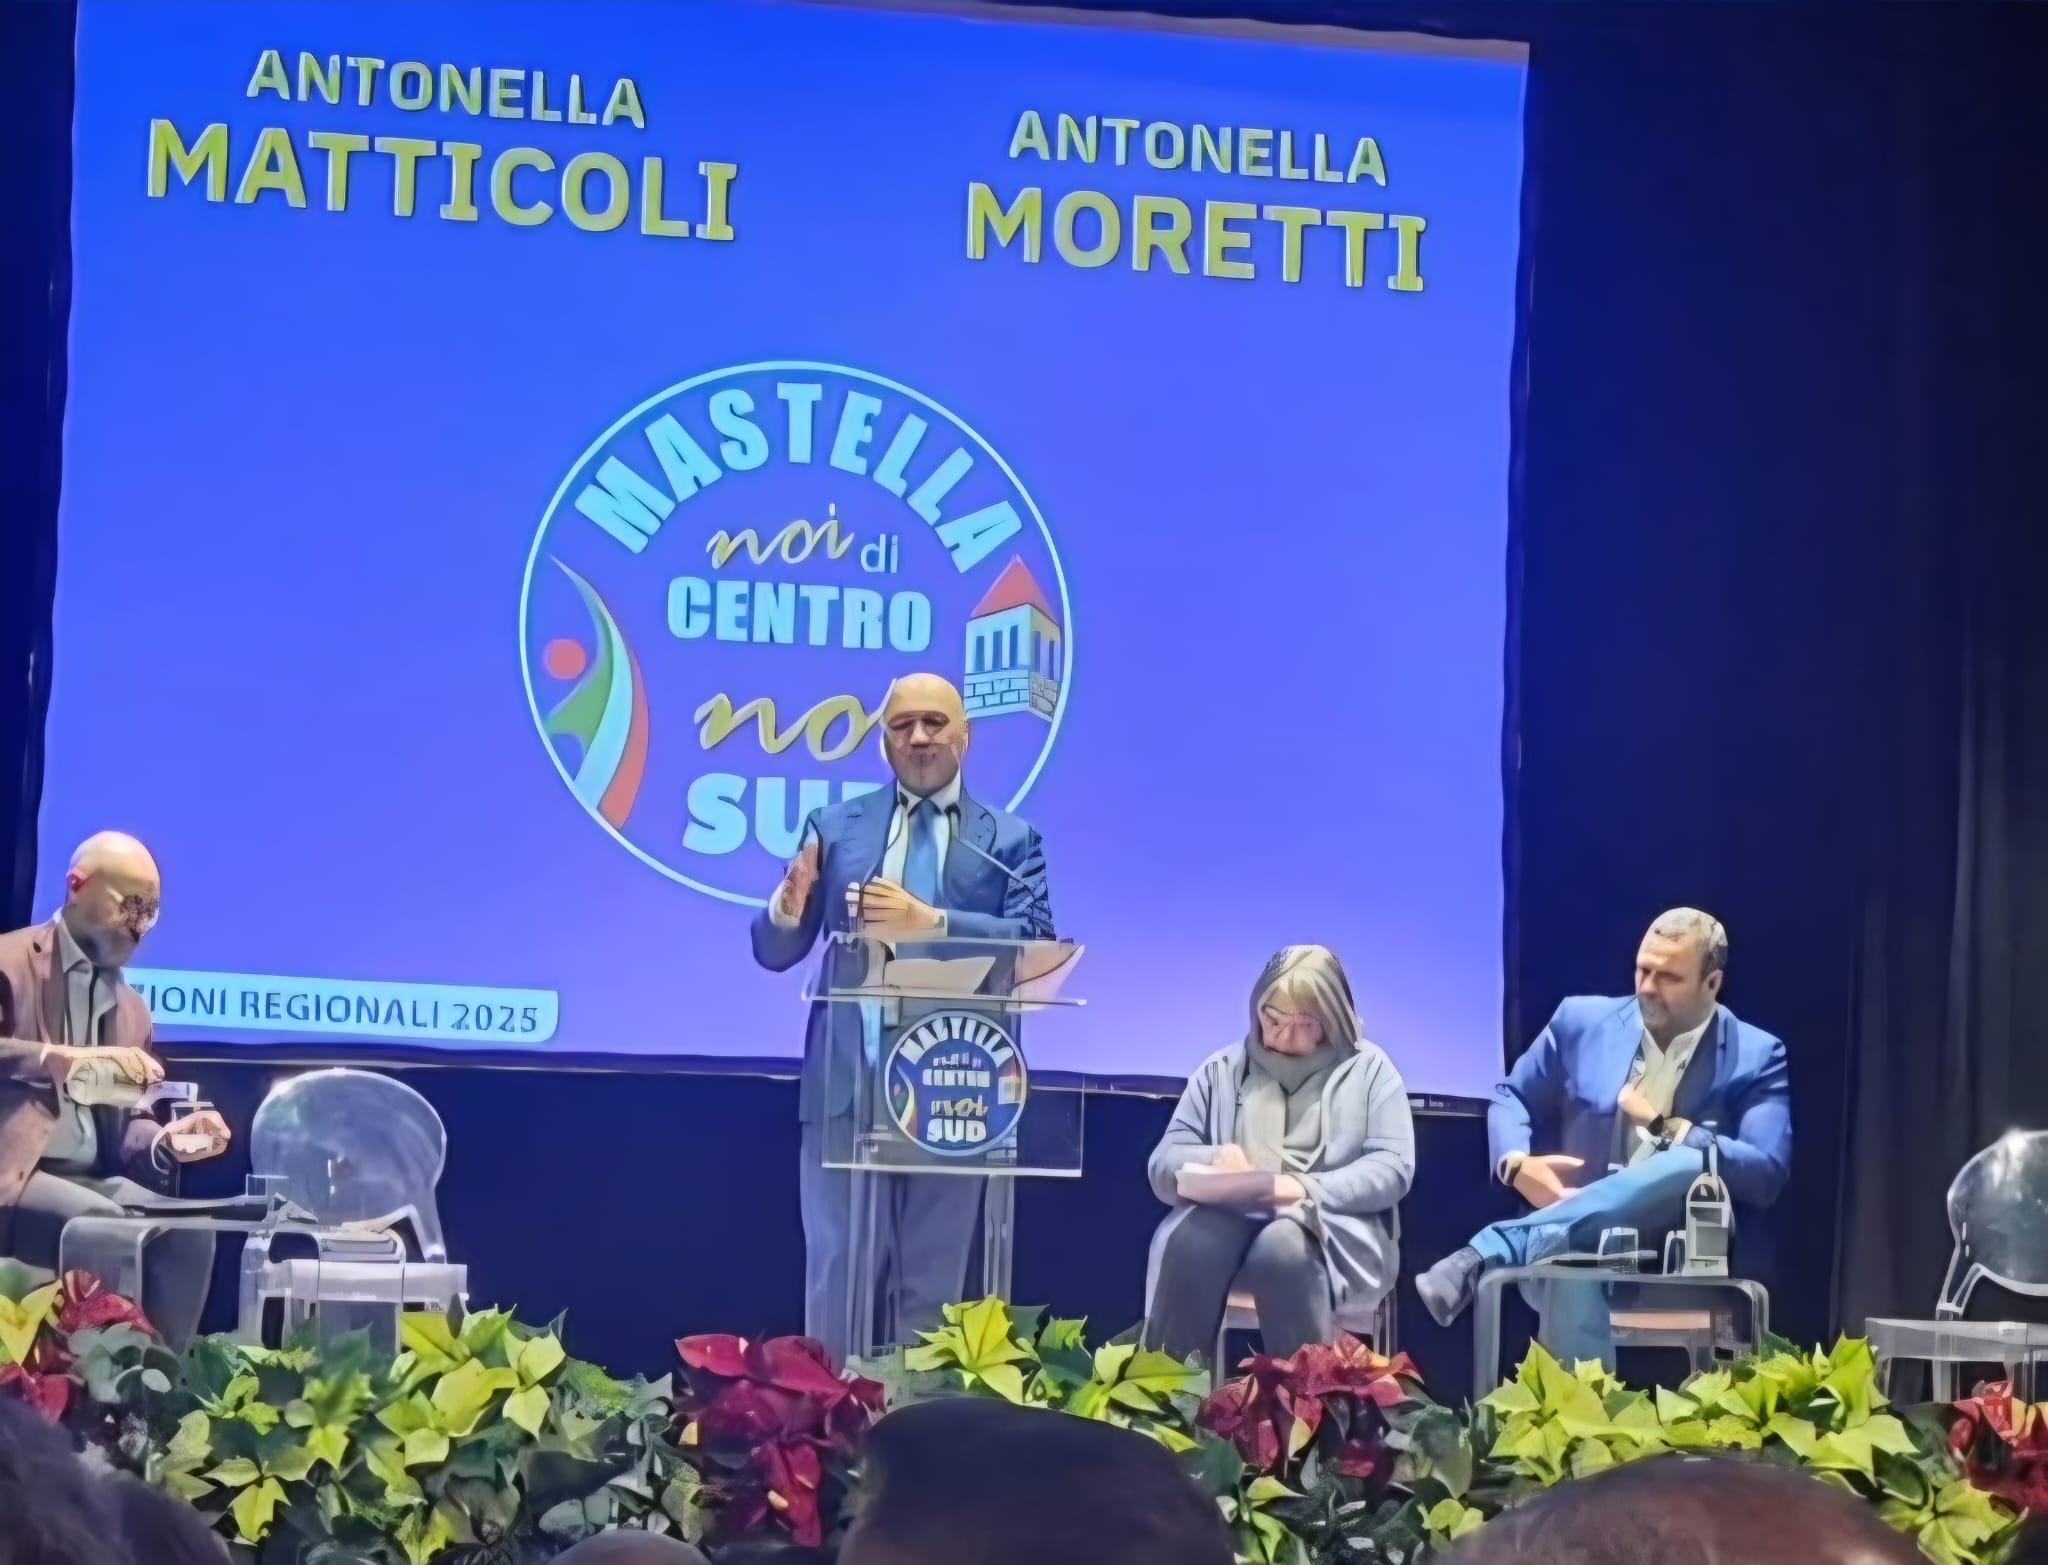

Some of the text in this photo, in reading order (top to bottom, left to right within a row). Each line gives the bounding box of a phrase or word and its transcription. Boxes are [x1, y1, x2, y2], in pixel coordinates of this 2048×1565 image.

[246, 49, 646, 129] ANTONELLA
[146, 118, 738, 242] MATTICOLI
[1008, 110, 1387, 186] ANTONELLA
[966, 181, 1427, 292] MORETTI
[574, 381, 1023, 574] MASTELLA
[706, 502, 899, 573] noi di
[667, 576, 932, 653] CENTRO
[693, 678, 900, 762] no
[240, 990, 438, 1030] REGIONALI
[450, 1003, 538, 1034] 2025
[926, 1118, 987, 1143] SUD
